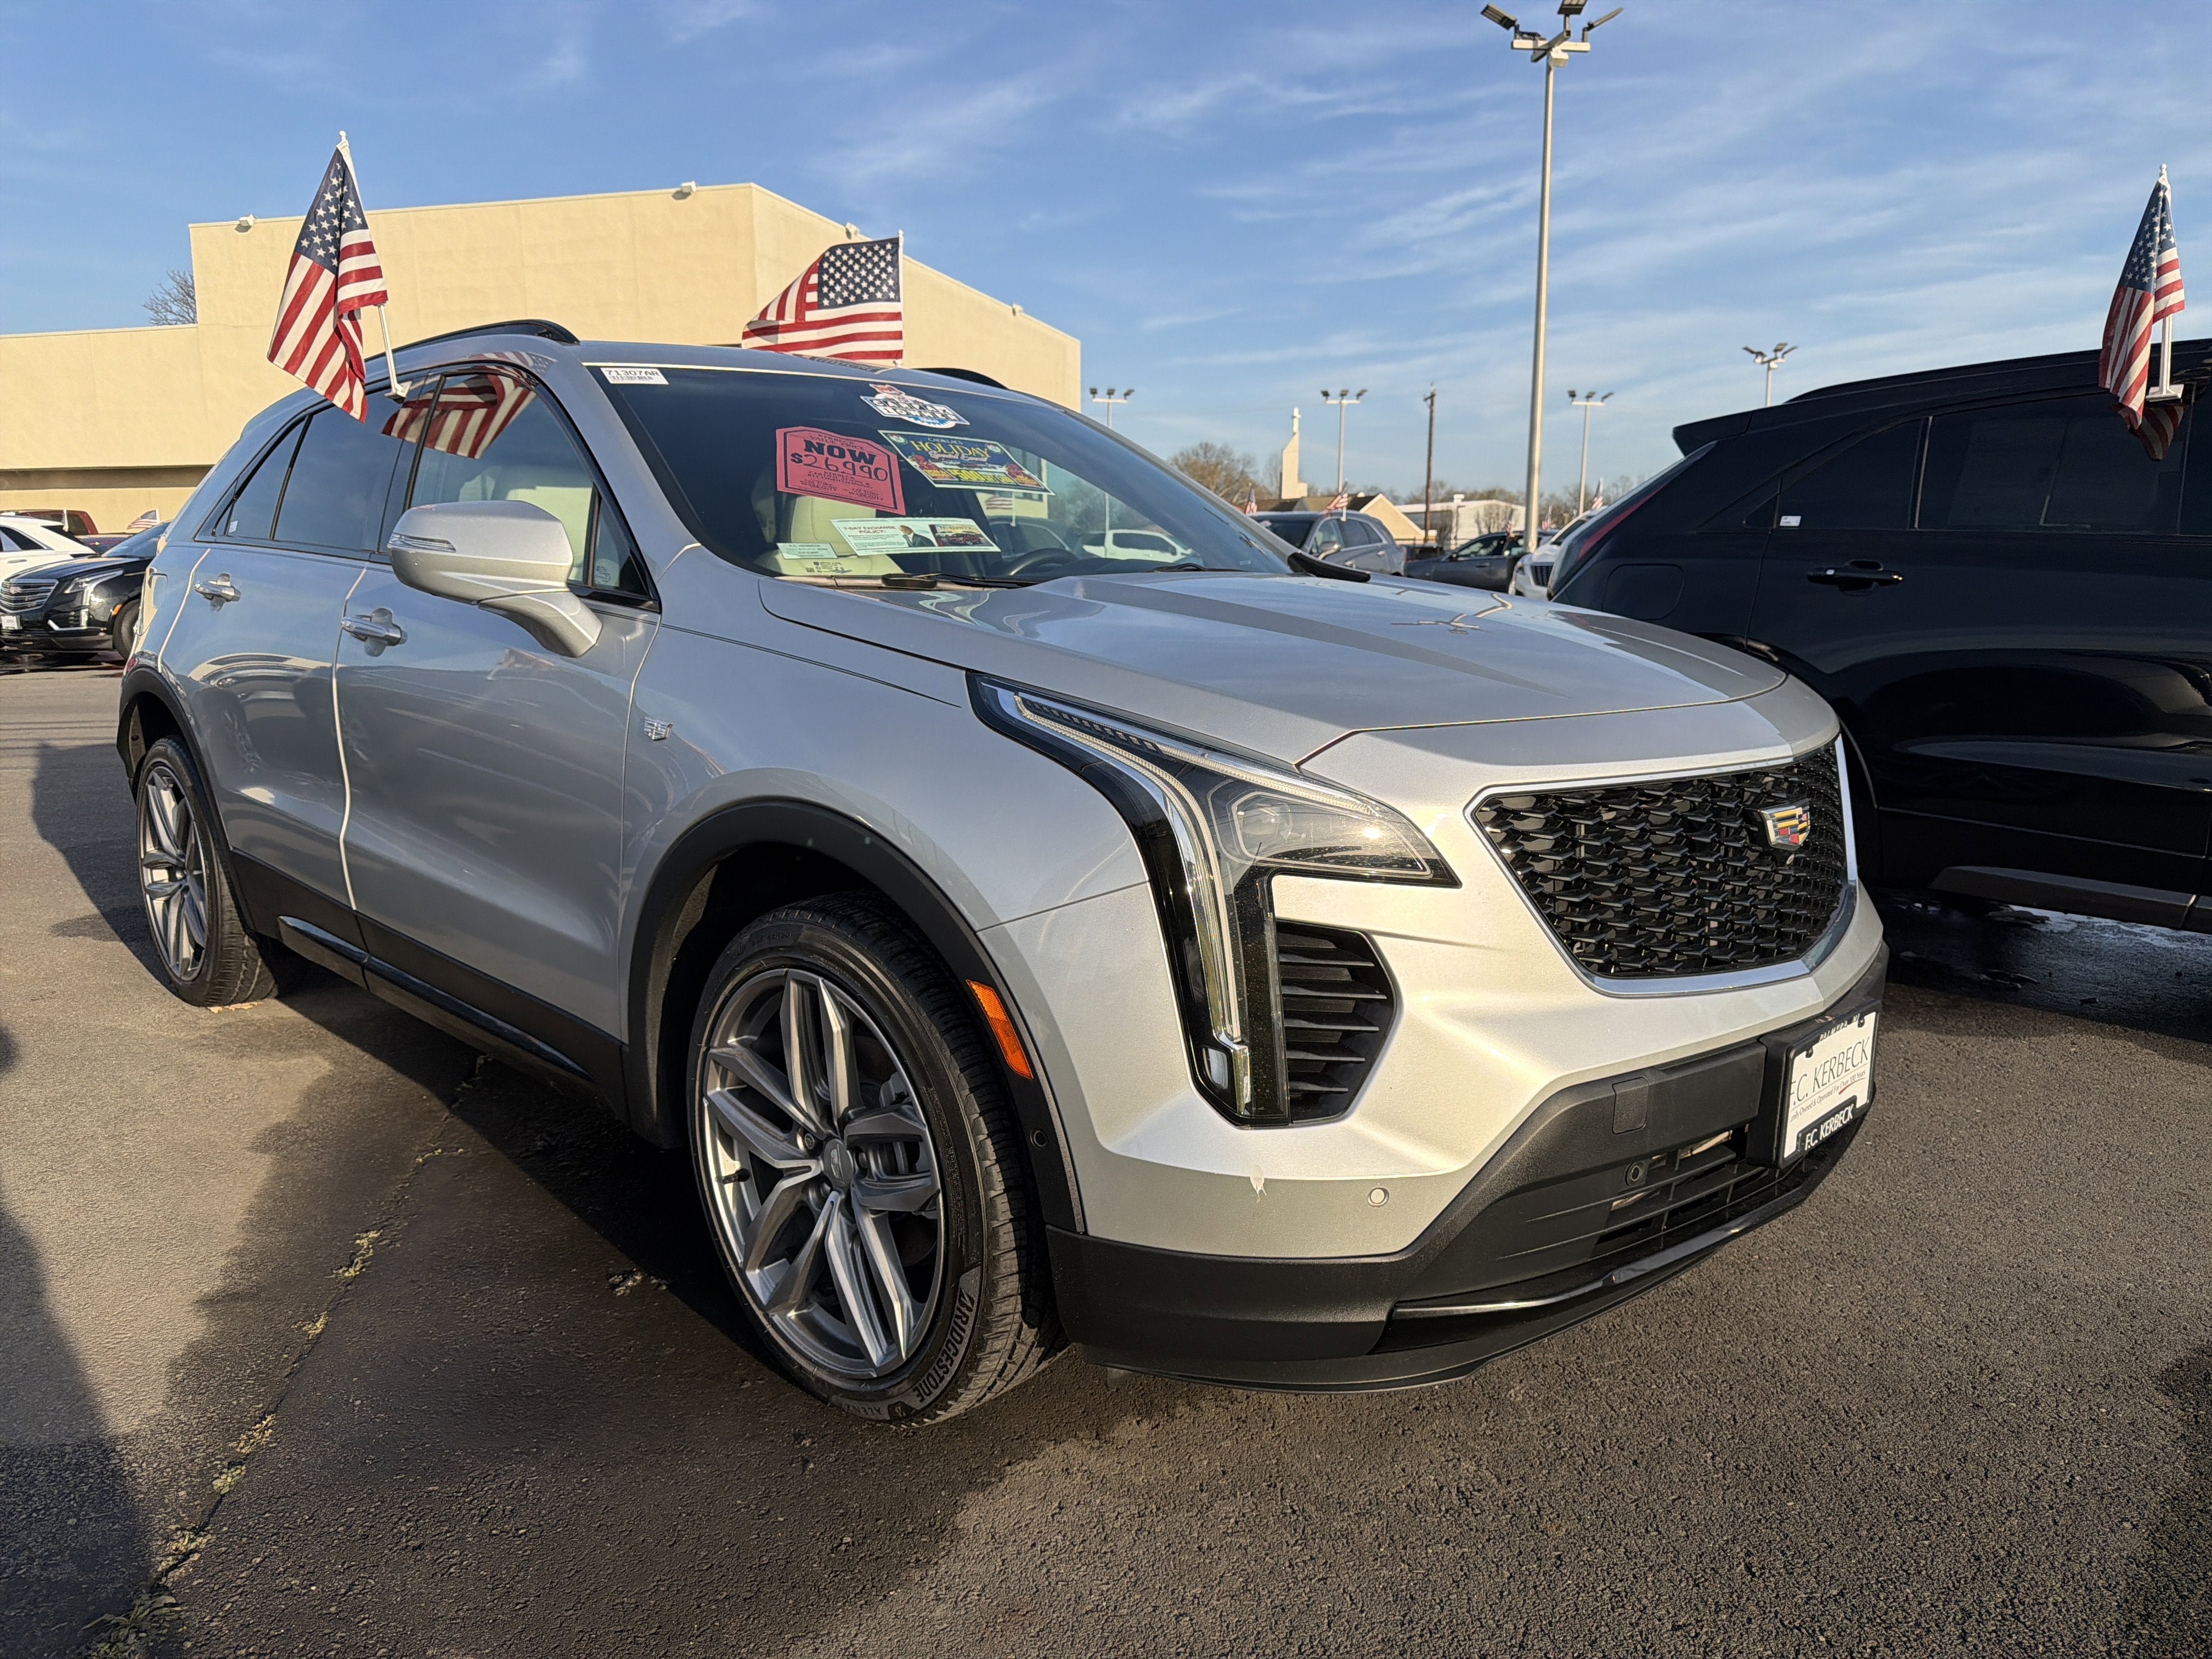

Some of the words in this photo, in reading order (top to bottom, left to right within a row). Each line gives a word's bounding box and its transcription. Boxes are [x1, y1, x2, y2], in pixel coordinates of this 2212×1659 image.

[804, 439, 876, 465] NOW
[910, 441, 991, 458] HOLIDAY
[1812, 1036, 1870, 1093] KERBECK
[1820, 1104, 1854, 1140] KERBECK
[912, 1289, 974, 1403] BRIDGESTONE
